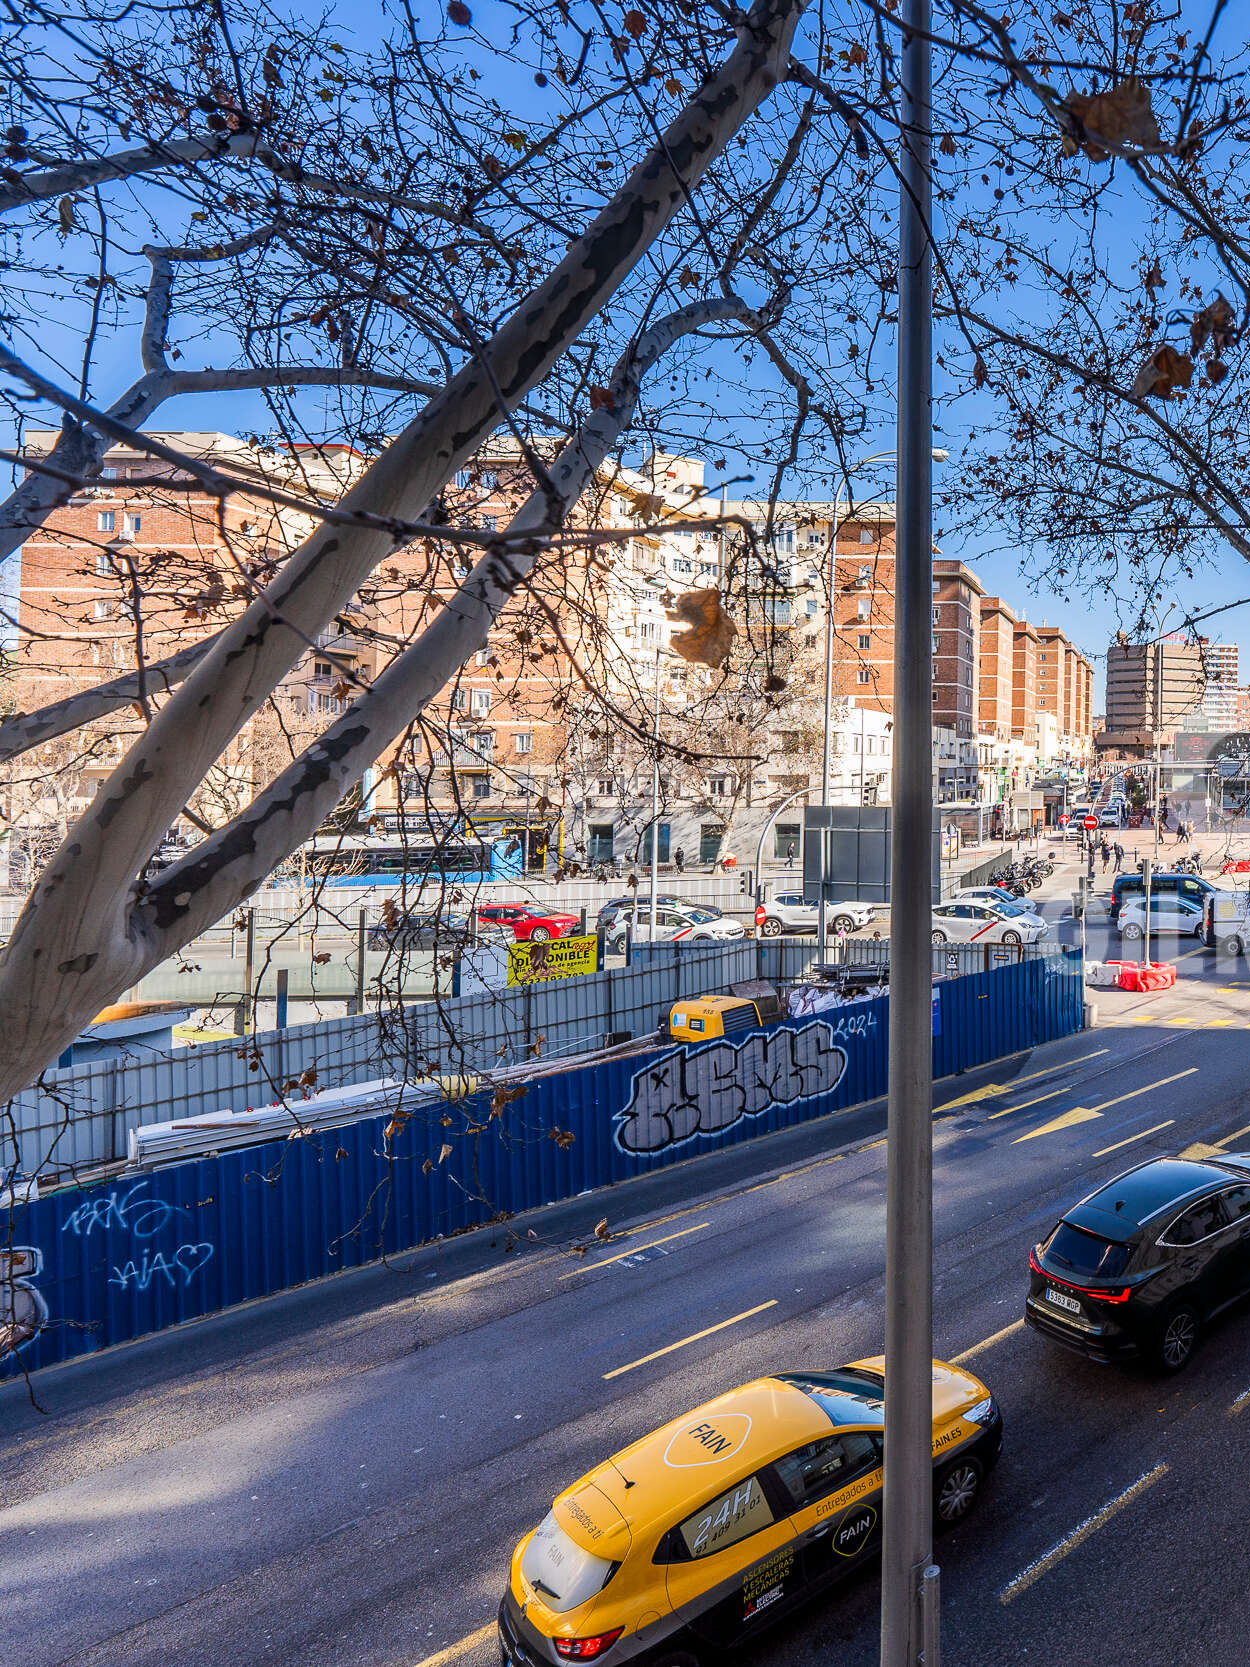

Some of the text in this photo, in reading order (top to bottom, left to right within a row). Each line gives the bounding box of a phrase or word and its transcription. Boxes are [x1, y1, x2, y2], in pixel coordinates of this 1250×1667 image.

[516, 950, 590, 967] DIONIBLE
[1050, 1291, 1065, 1305] 5363
[688, 1423, 732, 1455] FAIN
[931, 1427, 962, 1450] FAIN.ES
[563, 1497, 593, 1529] Entregados
[815, 1482, 867, 1517] Entregados
[868, 1477, 874, 1487] a
[693, 1479, 753, 1549] 24H
[711, 1521, 731, 1542] 409
[735, 1508, 746, 1523] 31
[749, 1496, 760, 1509] 01
[840, 1515, 870, 1545] FAIN
[743, 1545, 794, 1584] ASCENSORES
[743, 1556, 794, 1594] Y ESCALERAS
